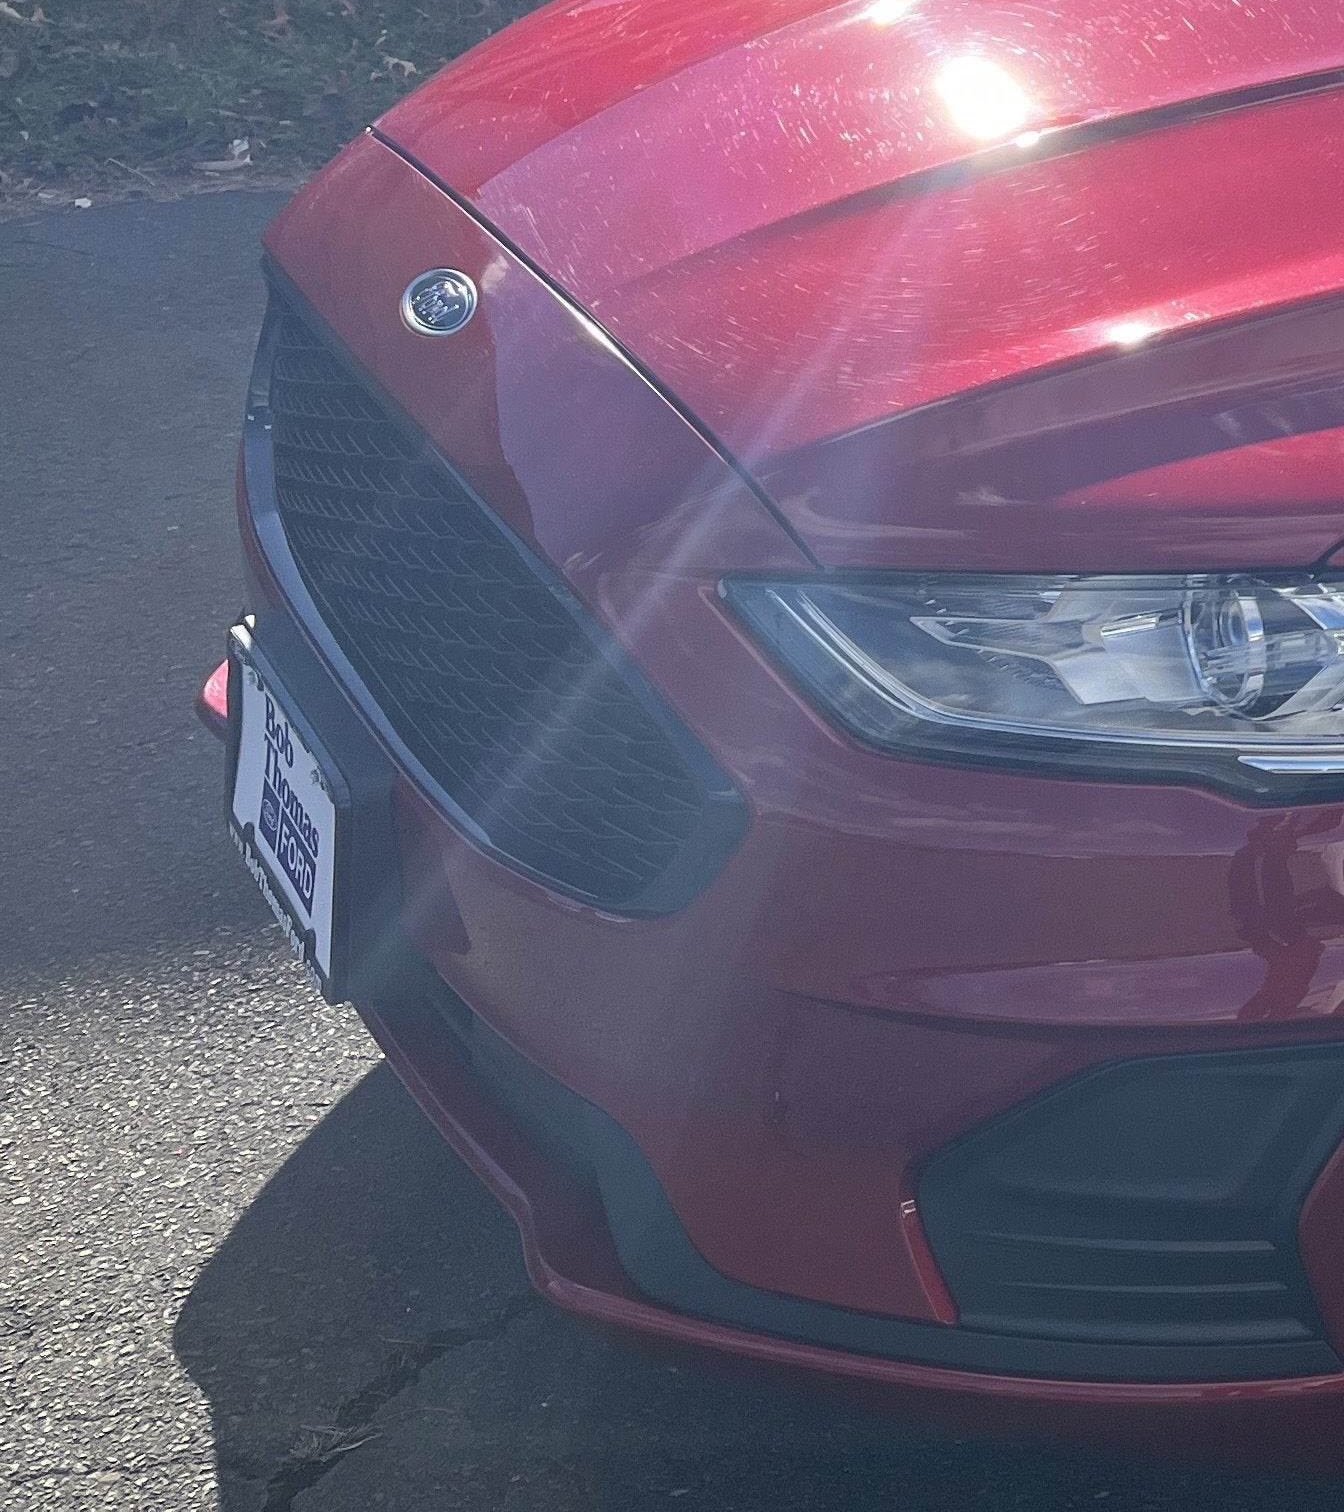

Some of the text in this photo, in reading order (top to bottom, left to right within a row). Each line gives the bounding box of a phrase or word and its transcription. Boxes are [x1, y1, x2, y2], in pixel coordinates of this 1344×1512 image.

[264, 691, 294, 769] Bob
[263, 729, 320, 858] Thomas
[279, 821, 313, 899] FORD
